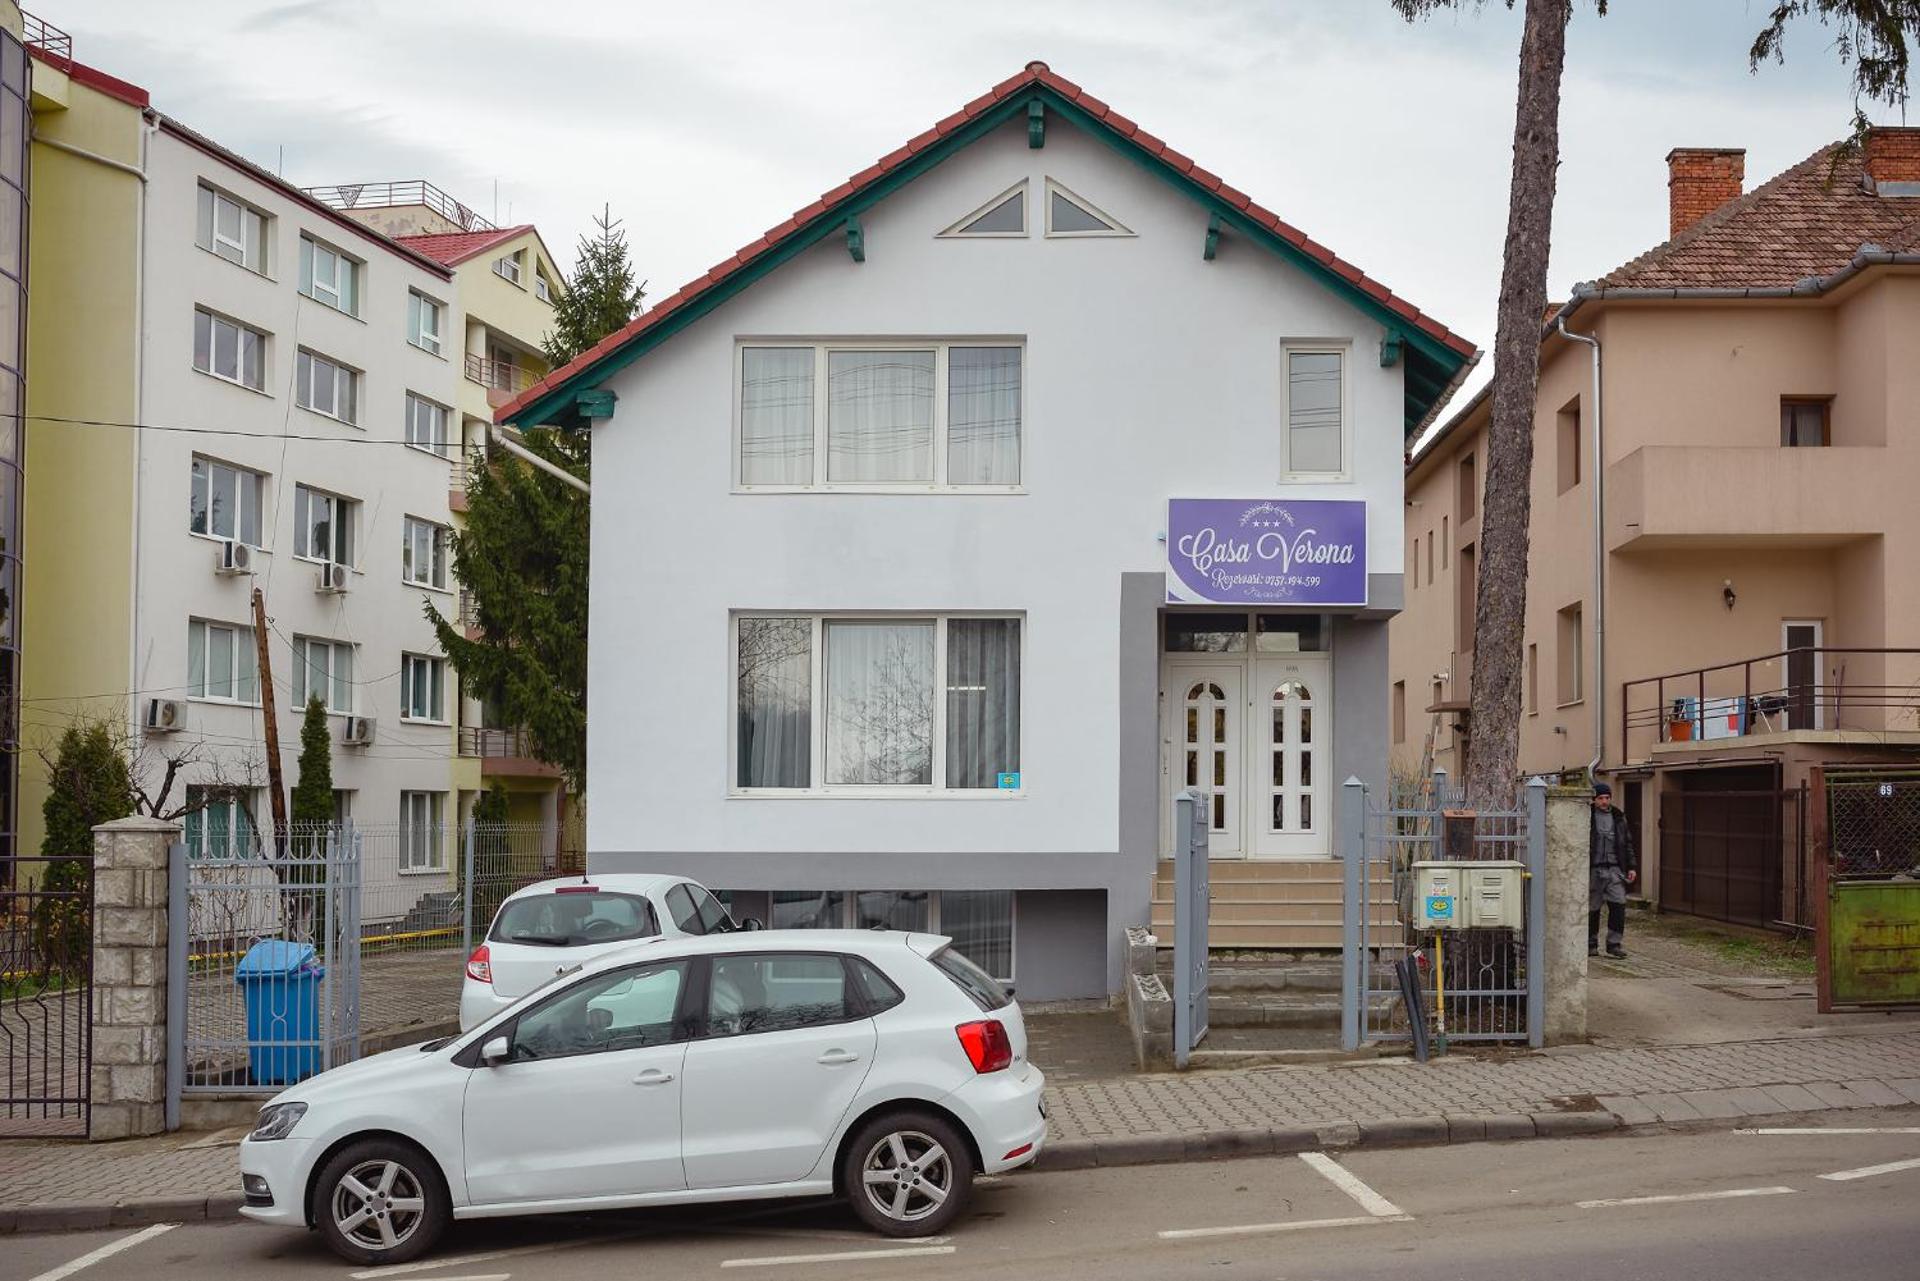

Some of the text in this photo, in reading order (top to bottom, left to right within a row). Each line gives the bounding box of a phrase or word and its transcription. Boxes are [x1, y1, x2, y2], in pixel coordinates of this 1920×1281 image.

[1178, 528, 1355, 577] Casa Verona
[1880, 785, 1892, 796] 69
